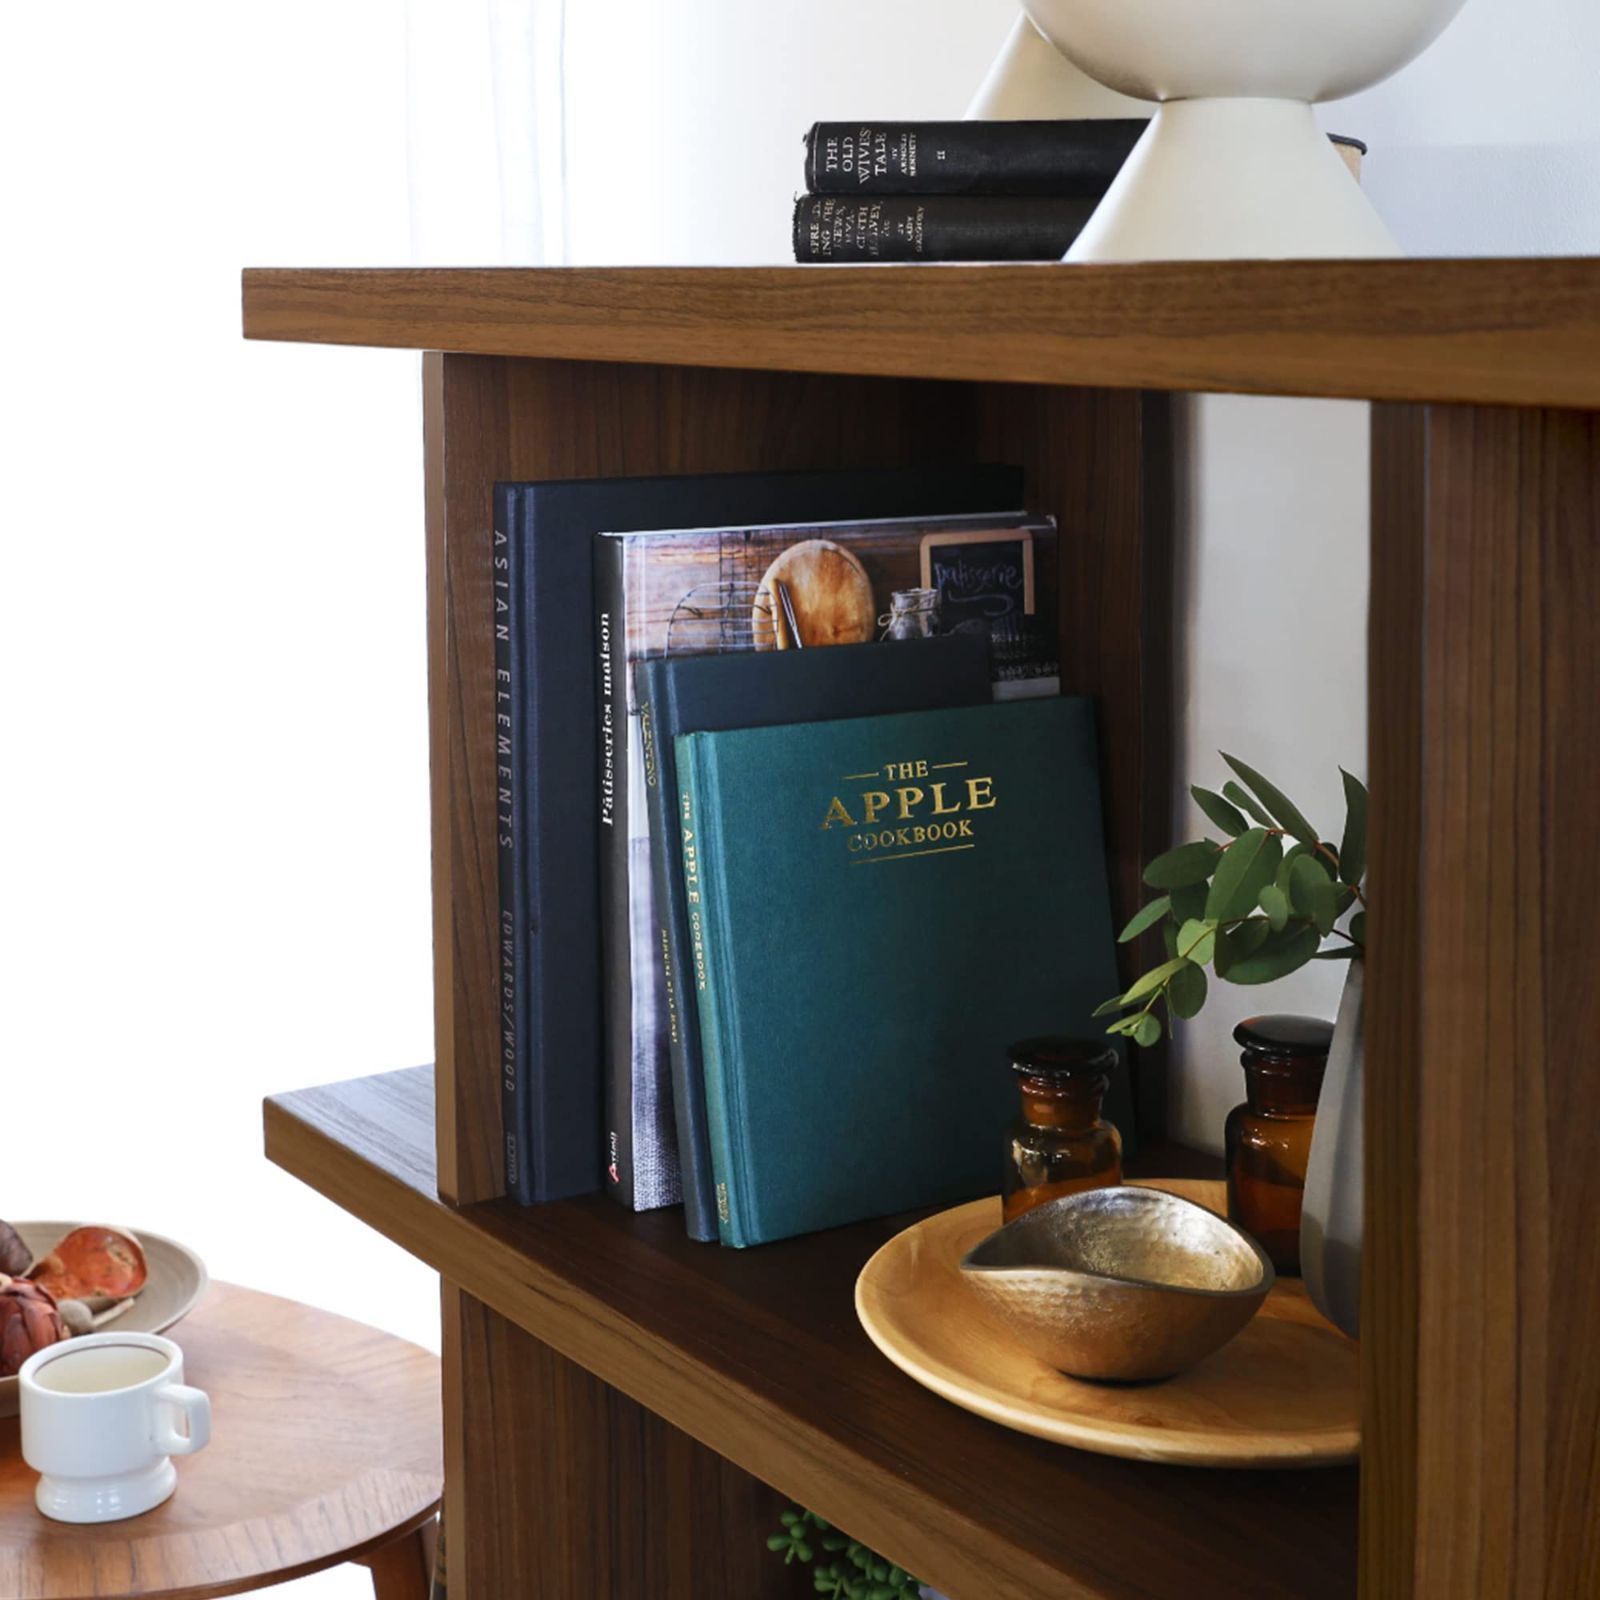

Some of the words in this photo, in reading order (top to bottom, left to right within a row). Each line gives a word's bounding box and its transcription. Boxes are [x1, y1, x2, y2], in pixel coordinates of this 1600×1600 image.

[826, 137, 838, 172] THE
[842, 136, 854, 172] OLD
[875, 132, 888, 176] TALE
[495, 530, 509, 640] ASIAN
[600, 613, 612, 696] maison
[498, 668, 512, 849] ELEMENTS
[602, 703, 614, 827] Pâtisseries
[884, 760, 929, 782] THE
[683, 792, 692, 820] THE
[821, 777, 998, 830] APPLE
[684, 829, 700, 904] APPLE
[849, 820, 975, 852] COOKBOOK
[692, 912, 706, 991] COOKBOOK
[503, 911, 516, 1092] EDWARDS/WOOD
